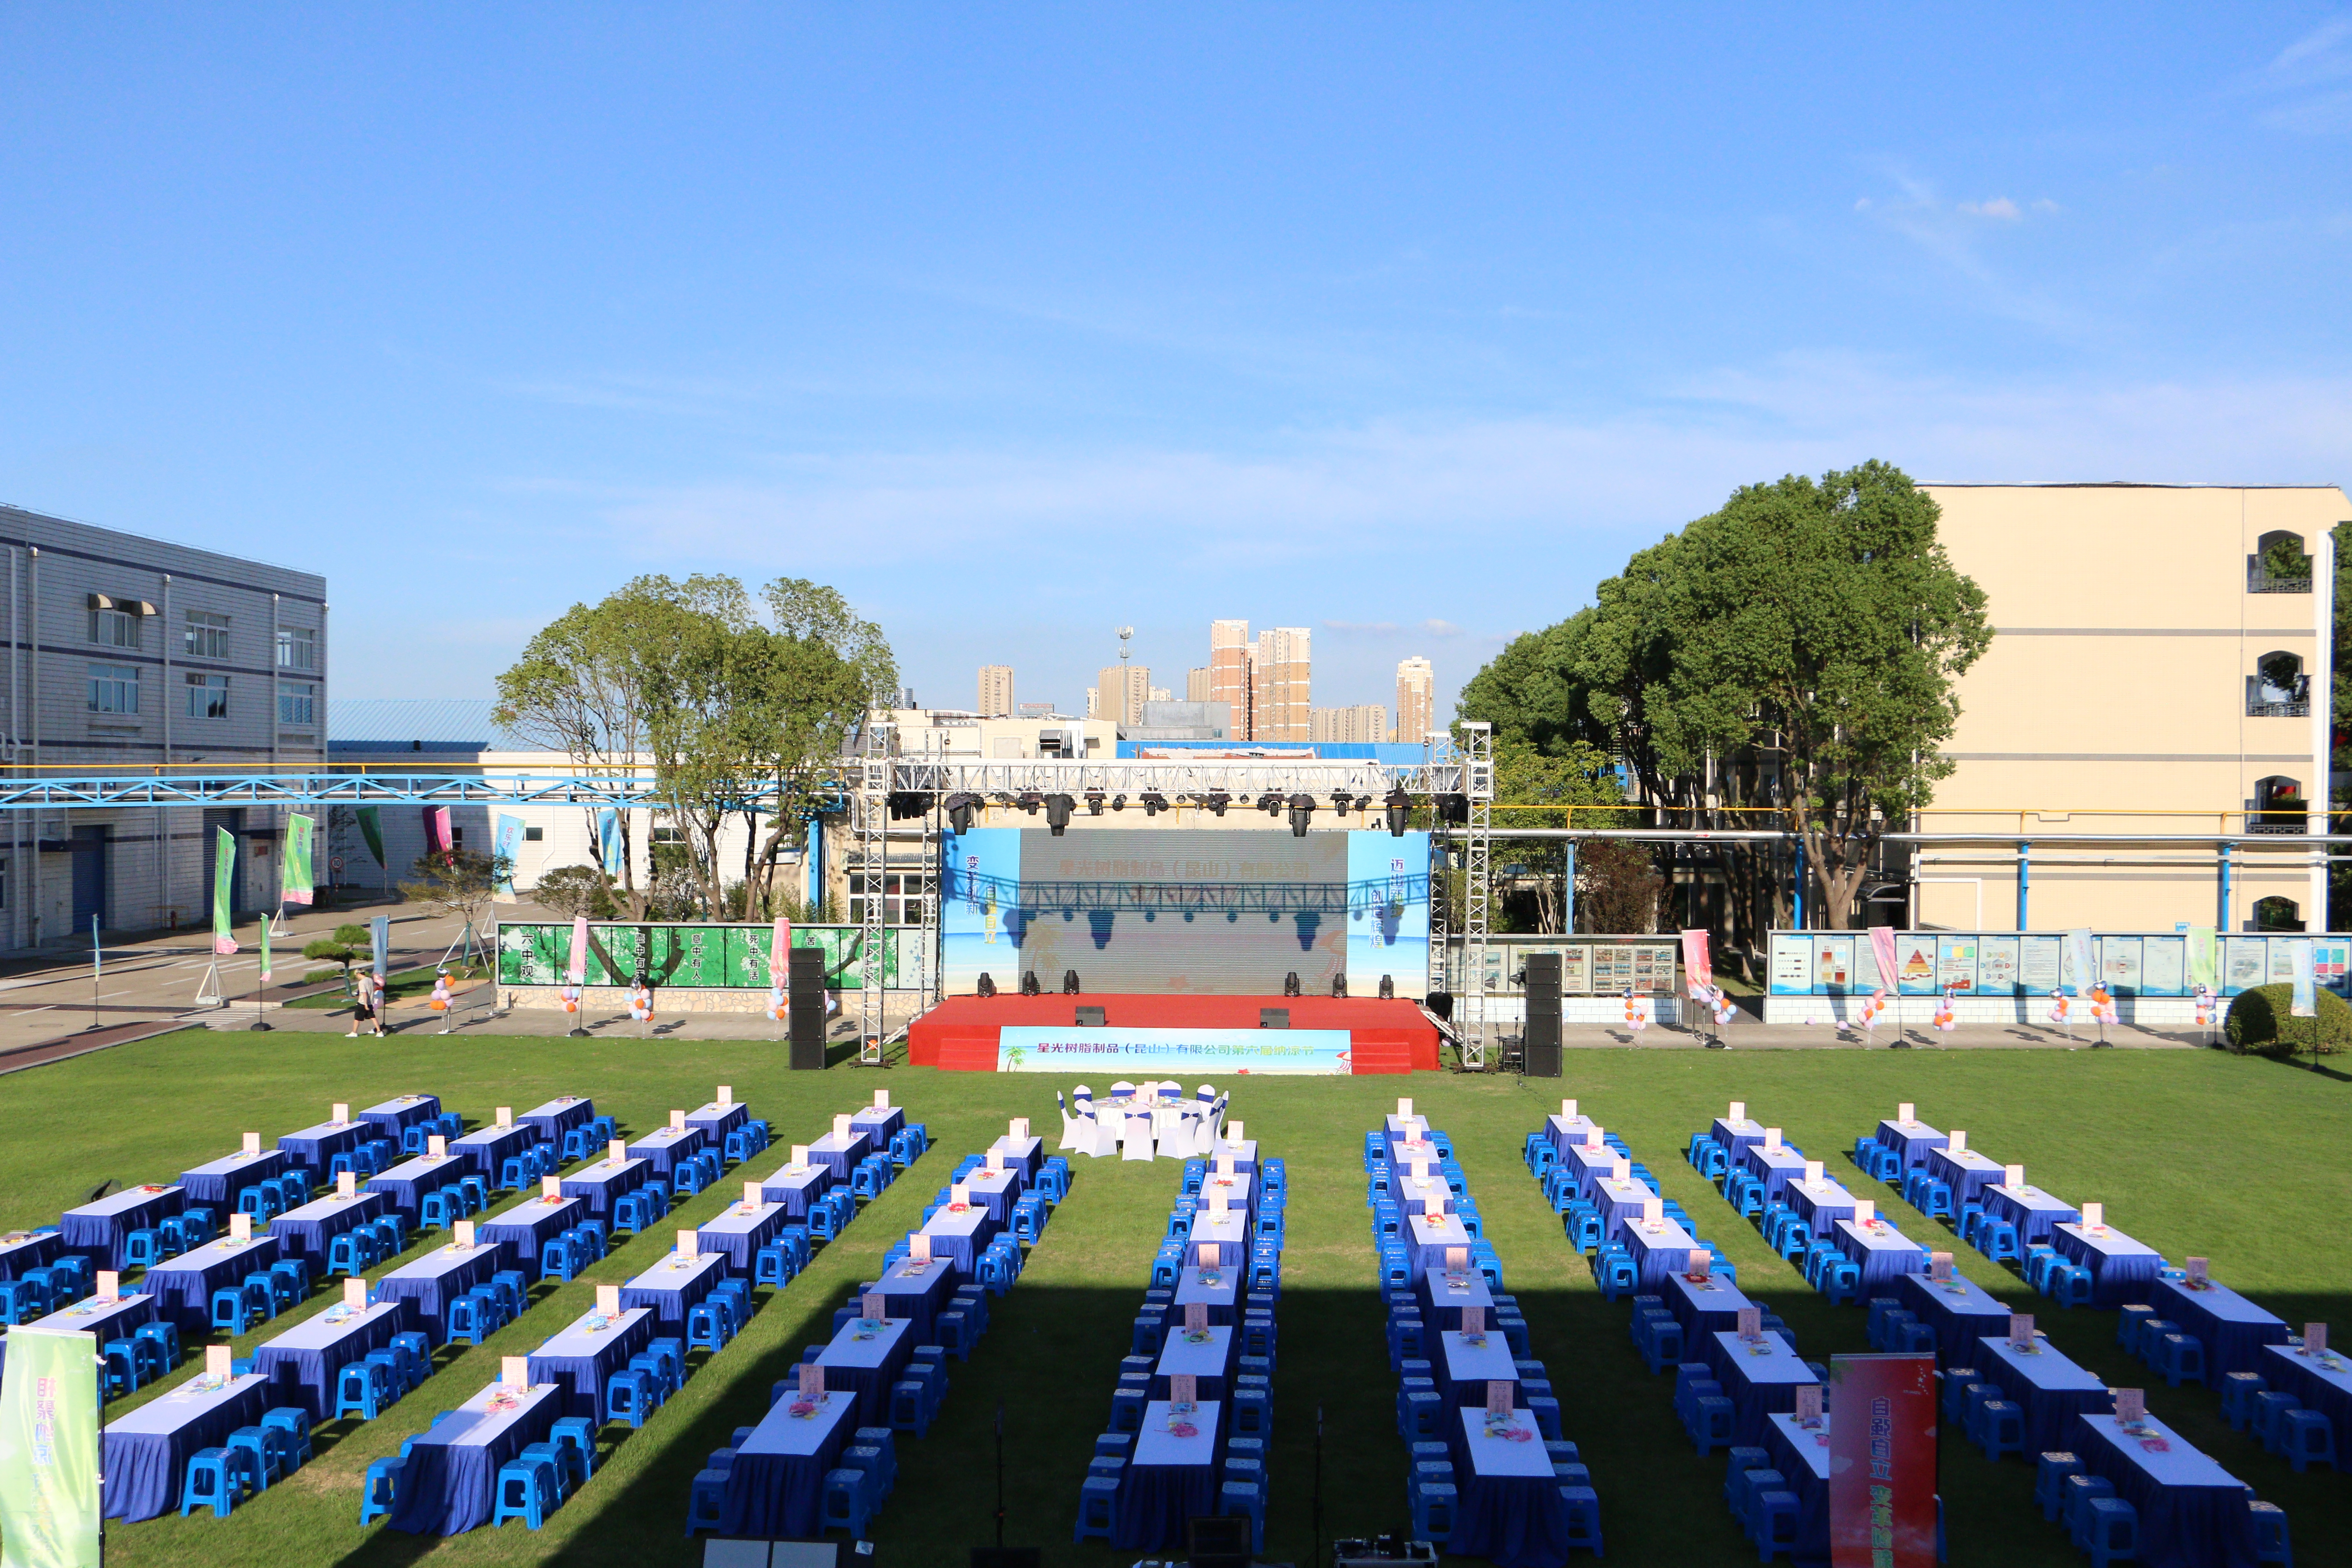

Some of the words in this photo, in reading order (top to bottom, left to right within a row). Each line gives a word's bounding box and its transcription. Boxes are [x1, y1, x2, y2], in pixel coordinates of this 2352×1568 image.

[966, 856, 979, 915] 变革创新
[1390, 858, 1404, 918] 迈出新步
[984, 885, 997, 944] 自强自立
[1369, 889, 1384, 949] 创造辉煌
[521, 933, 533, 977] 六中观
[634, 934, 645, 980] 壶中有天
[692, 934, 702, 980] 意中有人
[749, 935, 759, 980] 死中有活
[1037, 1043, 1314, 1056] 星光树脂制品（昆山）有限公司第六届纳凉节
